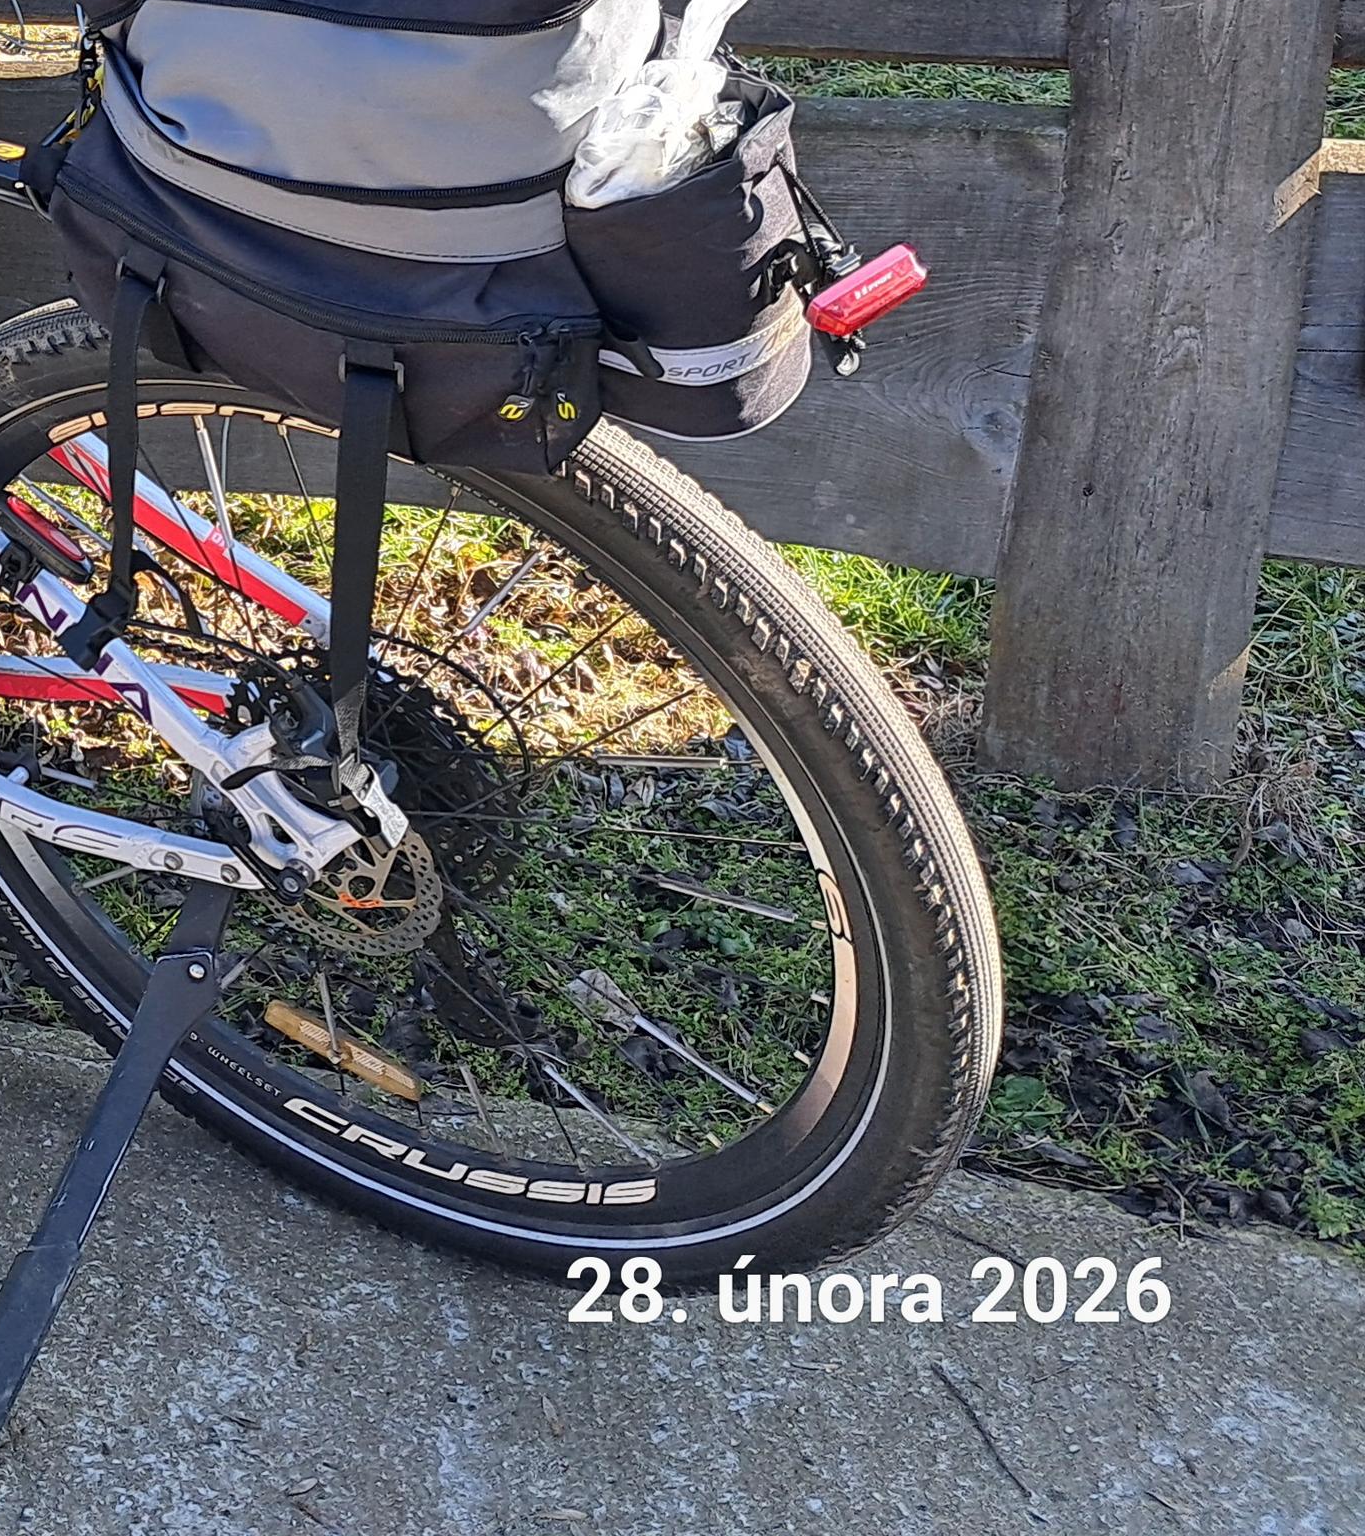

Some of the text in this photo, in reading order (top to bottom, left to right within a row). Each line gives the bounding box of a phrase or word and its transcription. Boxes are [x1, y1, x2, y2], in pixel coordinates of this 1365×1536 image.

[668, 354, 752, 378] SPORT
[206, 1044, 283, 1097] WHEELSET
[283, 1097, 657, 1205] CRUSSIS
